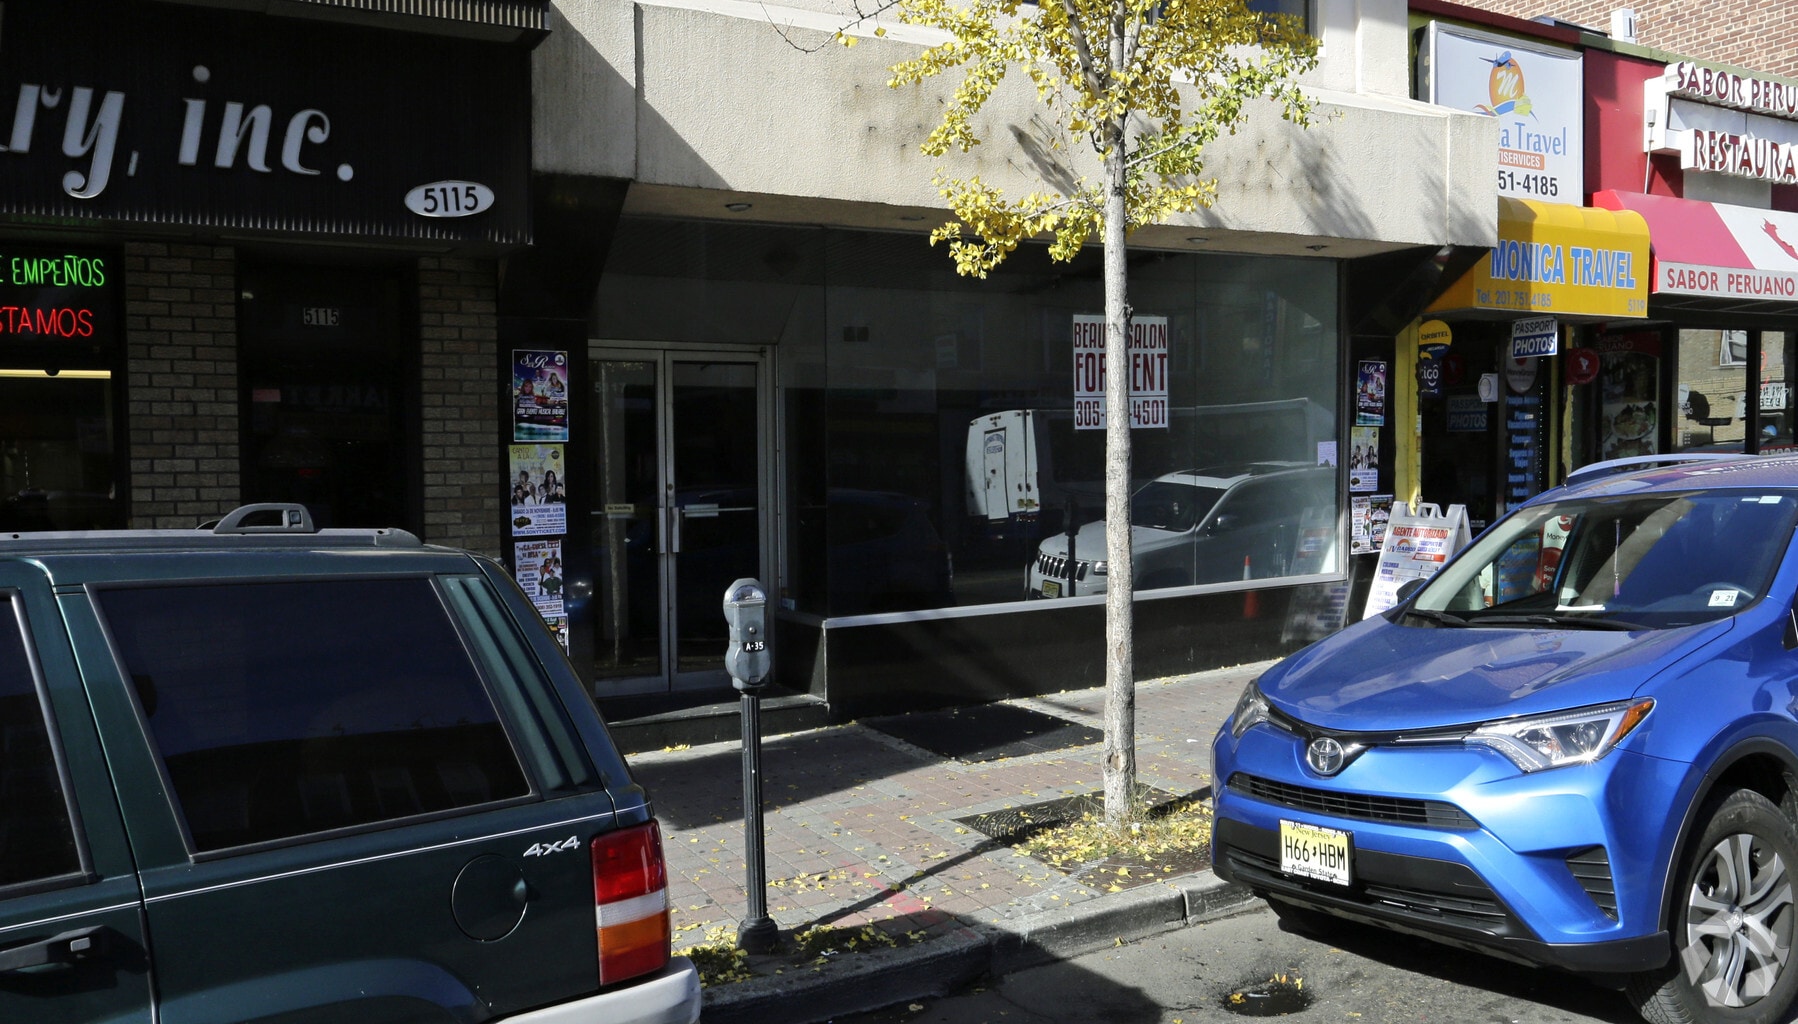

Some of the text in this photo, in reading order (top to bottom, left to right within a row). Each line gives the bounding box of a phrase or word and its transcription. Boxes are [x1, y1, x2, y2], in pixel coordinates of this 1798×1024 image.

[1677, 62, 1744, 103] SABOR
[0, 65, 354, 199] ry, inc.
[1515, 122, 1566, 156] Travel
[423, 186, 479, 213] 5115
[12, 255, 105, 287] EMPEÑOS
[1490, 239, 1636, 289] MONICA TRAVEL
[1667, 268, 1795, 296] SABOR PERUANO
[1476, 289, 1552, 307] Tel. 201.751.4185
[1628, 299, 1644, 312] 5119
[0, 306, 93, 337] TAMOS
[304, 308, 338, 325] 5115
[1515, 319, 1555, 334] PASSPORT
[1074, 323, 1166, 349] BEAU SALON
[1514, 336, 1555, 354] PHOTOS
[1075, 353, 1167, 392] FOR ENT
[1076, 400, 1165, 427] 305--4501
[1393, 526, 1449, 540] AGENTE AUTORIZADO
[1296, 827, 1310, 835] New
[1311, 830, 1331, 841] Jersey
[1298, 864, 1318, 873] Garden
